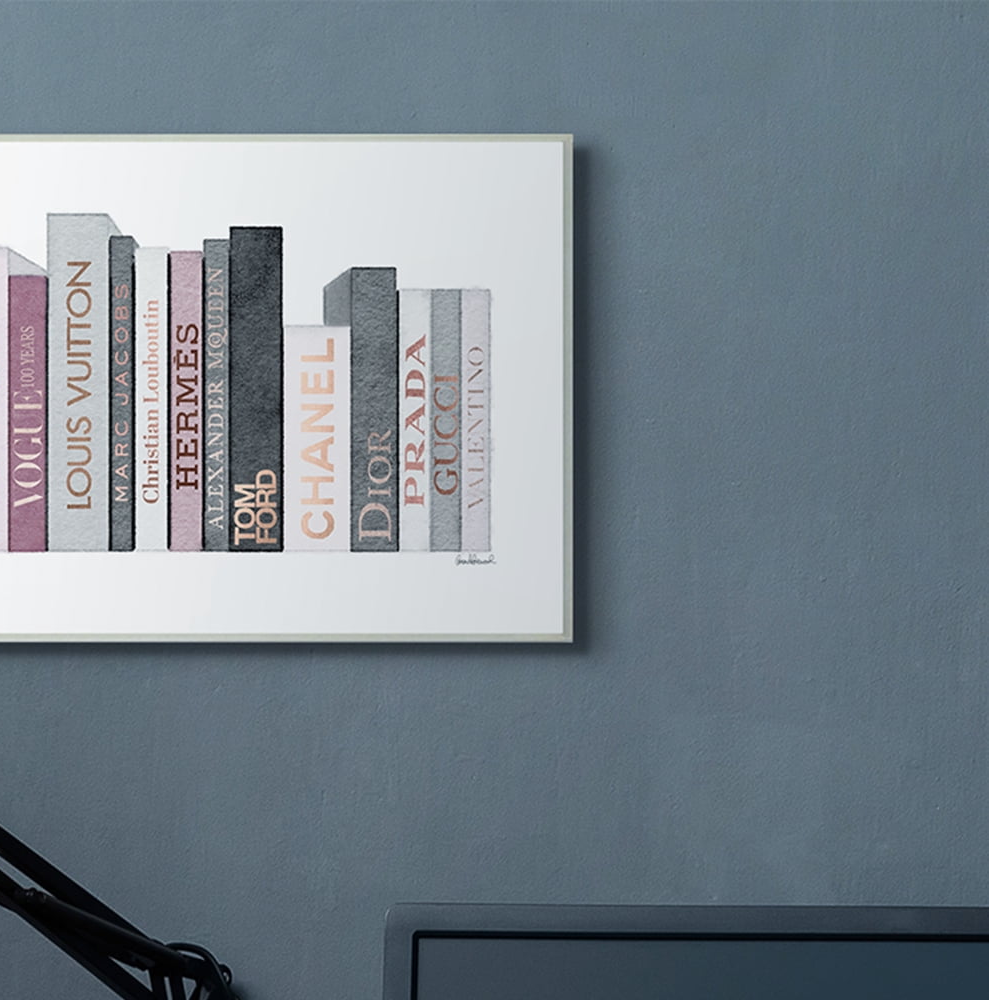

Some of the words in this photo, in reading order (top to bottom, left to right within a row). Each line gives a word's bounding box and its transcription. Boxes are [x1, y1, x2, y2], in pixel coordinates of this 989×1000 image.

[20, 325, 36, 364] YEARS
[20, 368, 36, 388] 100
[66, 261, 92, 406] VUITTON
[115, 283, 129, 406] JACOBS
[142, 299, 160, 403] Louboutin
[13, 389, 43, 508] VOGUE
[66, 416, 92, 510] LOUIS
[115, 421, 129, 502] MARC
[142, 408, 160, 504] Christian
[208, 380, 224, 530] ALEXANDER
[300, 337, 335, 540] CHANEL
[404, 333, 427, 507] PRADA
[433, 374, 459, 496] GUCCI
[467, 346, 485, 510] VALENTINO
[234, 484, 256, 546] TOM
[255, 469, 278, 544] FORD
[358, 429, 392, 542] DIOR
